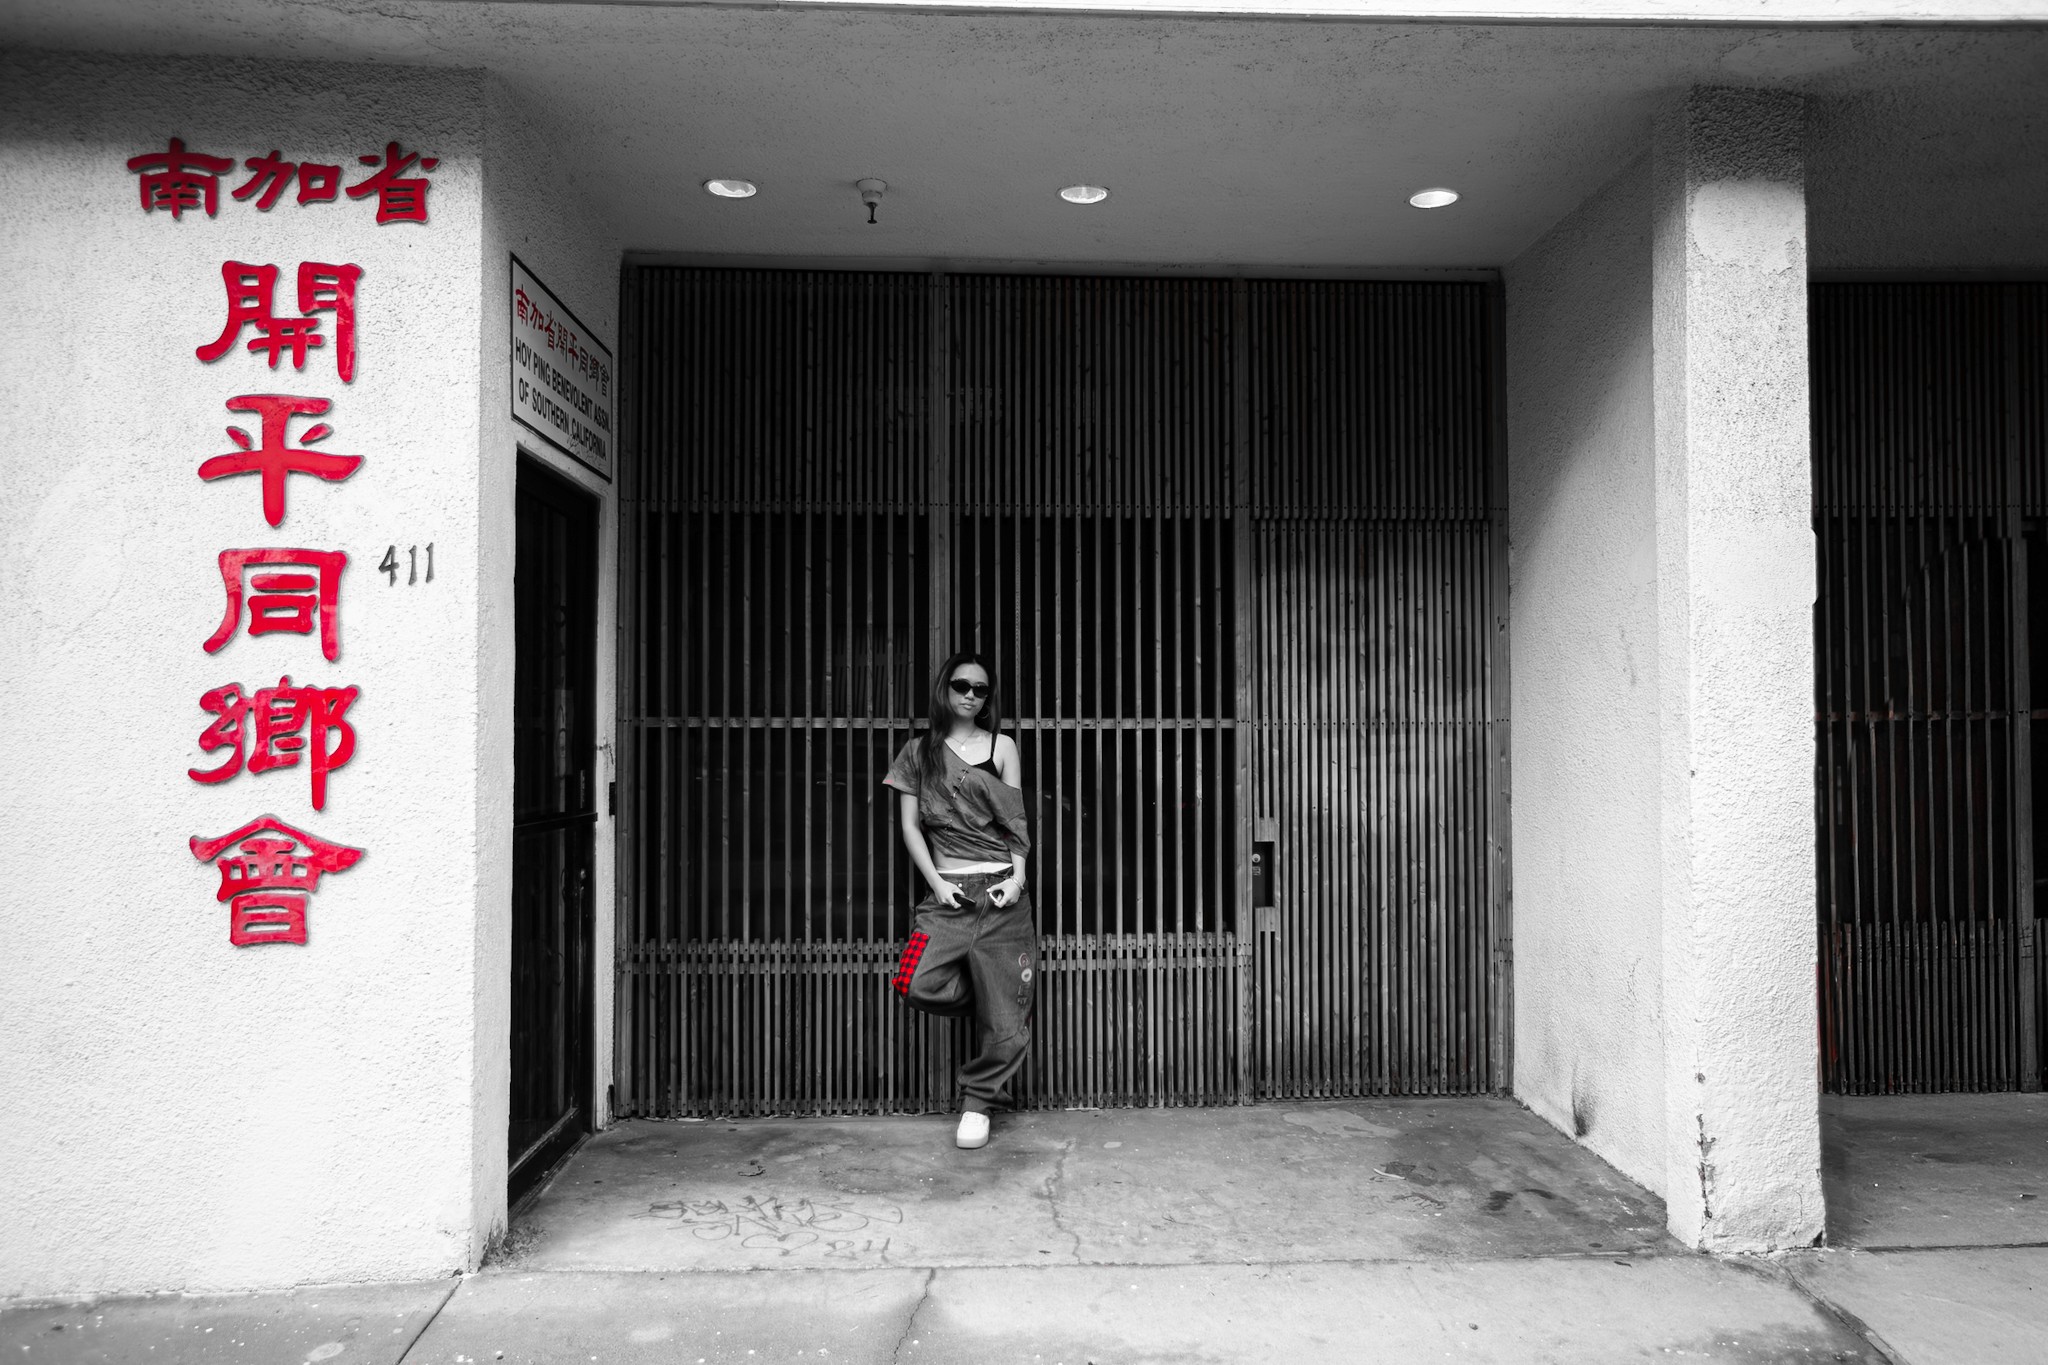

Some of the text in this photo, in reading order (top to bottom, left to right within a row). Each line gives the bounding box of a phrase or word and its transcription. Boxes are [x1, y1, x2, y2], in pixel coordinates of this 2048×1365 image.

[127, 139, 440, 224] 南加省
[516, 337, 531, 371] HOY
[533, 351, 551, 387] PING
[552, 368, 593, 420] BENEVOLENT
[519, 377, 529, 405] OF
[532, 387, 570, 435] SOUTHERN
[571, 417, 607, 461] CALIFORNIA
[378, 542, 435, 587] 411
